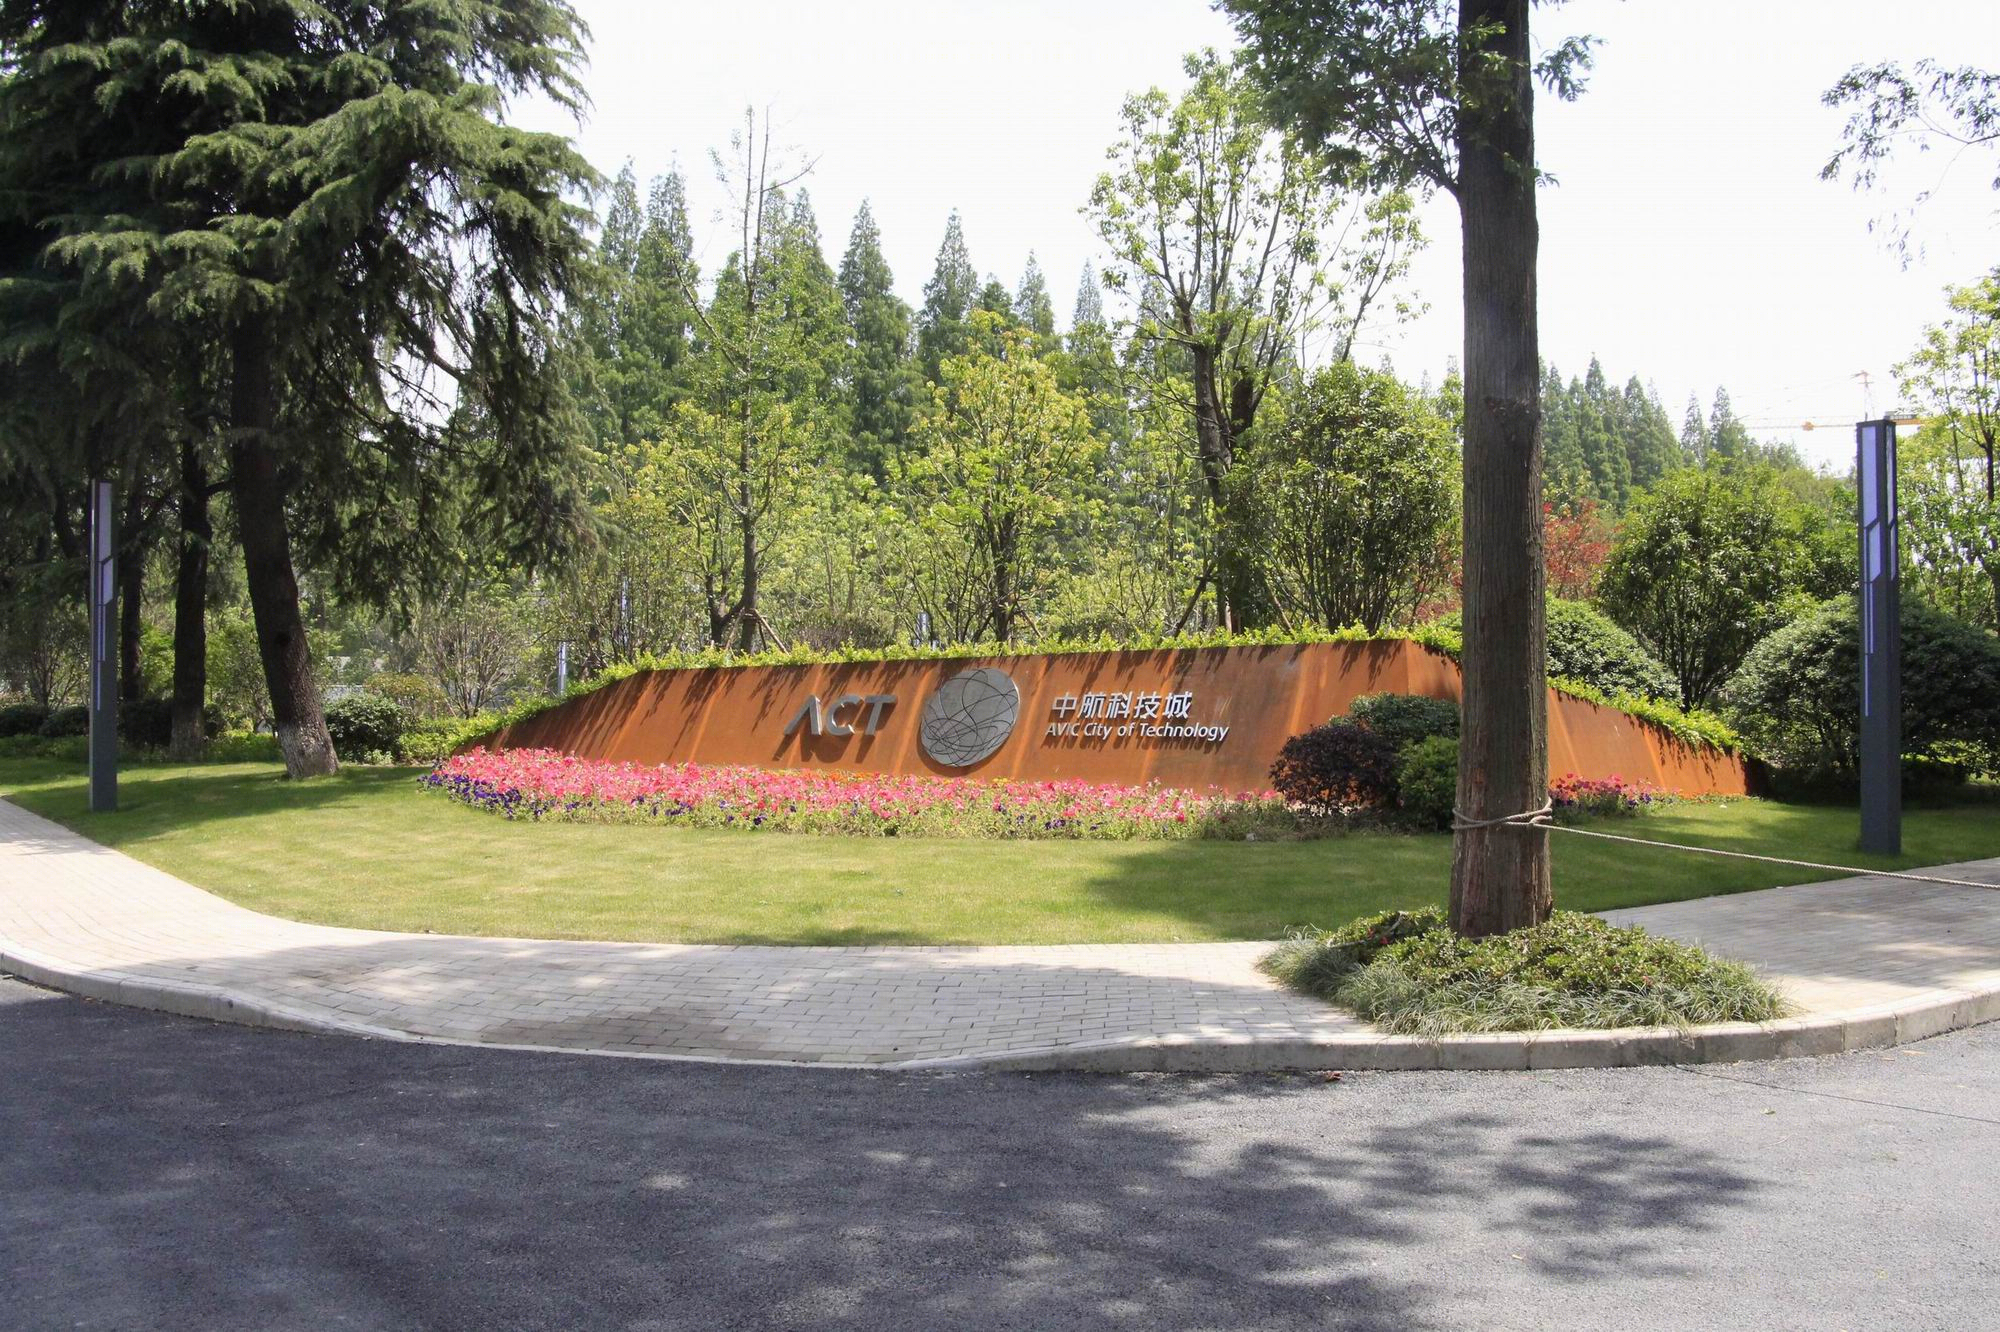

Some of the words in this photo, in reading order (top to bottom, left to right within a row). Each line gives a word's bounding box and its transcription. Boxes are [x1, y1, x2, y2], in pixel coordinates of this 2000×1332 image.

[784, 694, 897, 736] ACT
[1052, 691, 1193, 719] 中航科技城
[1045, 722, 1080, 737] AVIC
[1084, 722, 1113, 740] City
[1117, 722, 1136, 737] of
[1139, 722, 1230, 741] Technology
